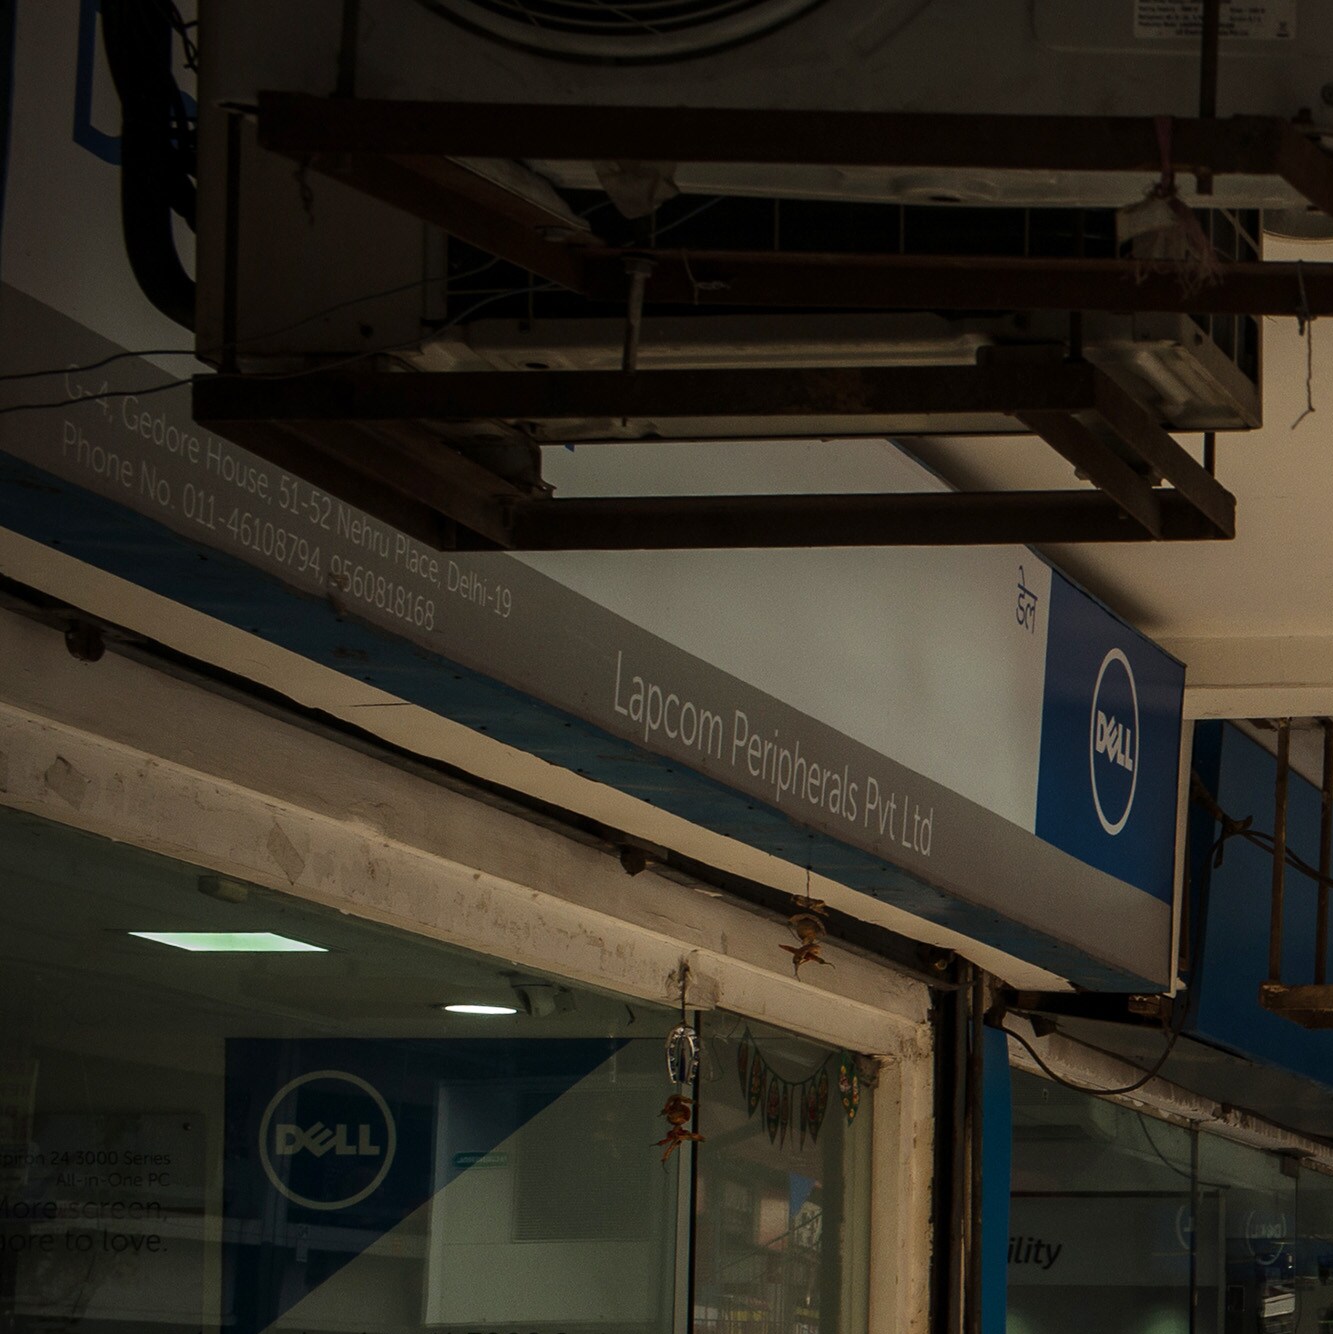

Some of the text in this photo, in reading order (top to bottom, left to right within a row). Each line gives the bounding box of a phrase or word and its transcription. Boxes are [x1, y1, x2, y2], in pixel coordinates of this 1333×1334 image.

[63, 421, 133, 487] Phone
[141, 459, 175, 508] No.
[183, 483, 324, 586] 011-46108794,
[122, 395, 200, 464] Gedore
[207, 437, 271, 500] House,
[279, 476, 332, 530] 51-52
[337, 503, 389, 559] Nehru
[395, 534, 442, 586] Place,
[447, 561, 513, 618] Delhi-19
[1017, 565, 1038, 632] डेल
[614, 650, 932, 856] Lapcom Peripherals Pvt Ltd
[1096, 708, 1133, 771] DELL
[50, 1151, 69, 1166] 24
[75, 1151, 118, 1166] 3000
[123, 1151, 171, 1166] Series
[275, 1121, 381, 1158] DELL
[56, 1172, 171, 1187] All-in-One PC
[69, 1203, 168, 1223] screen,
[65, 1231, 92, 1252] to
[103, 1228, 168, 1252] love.
